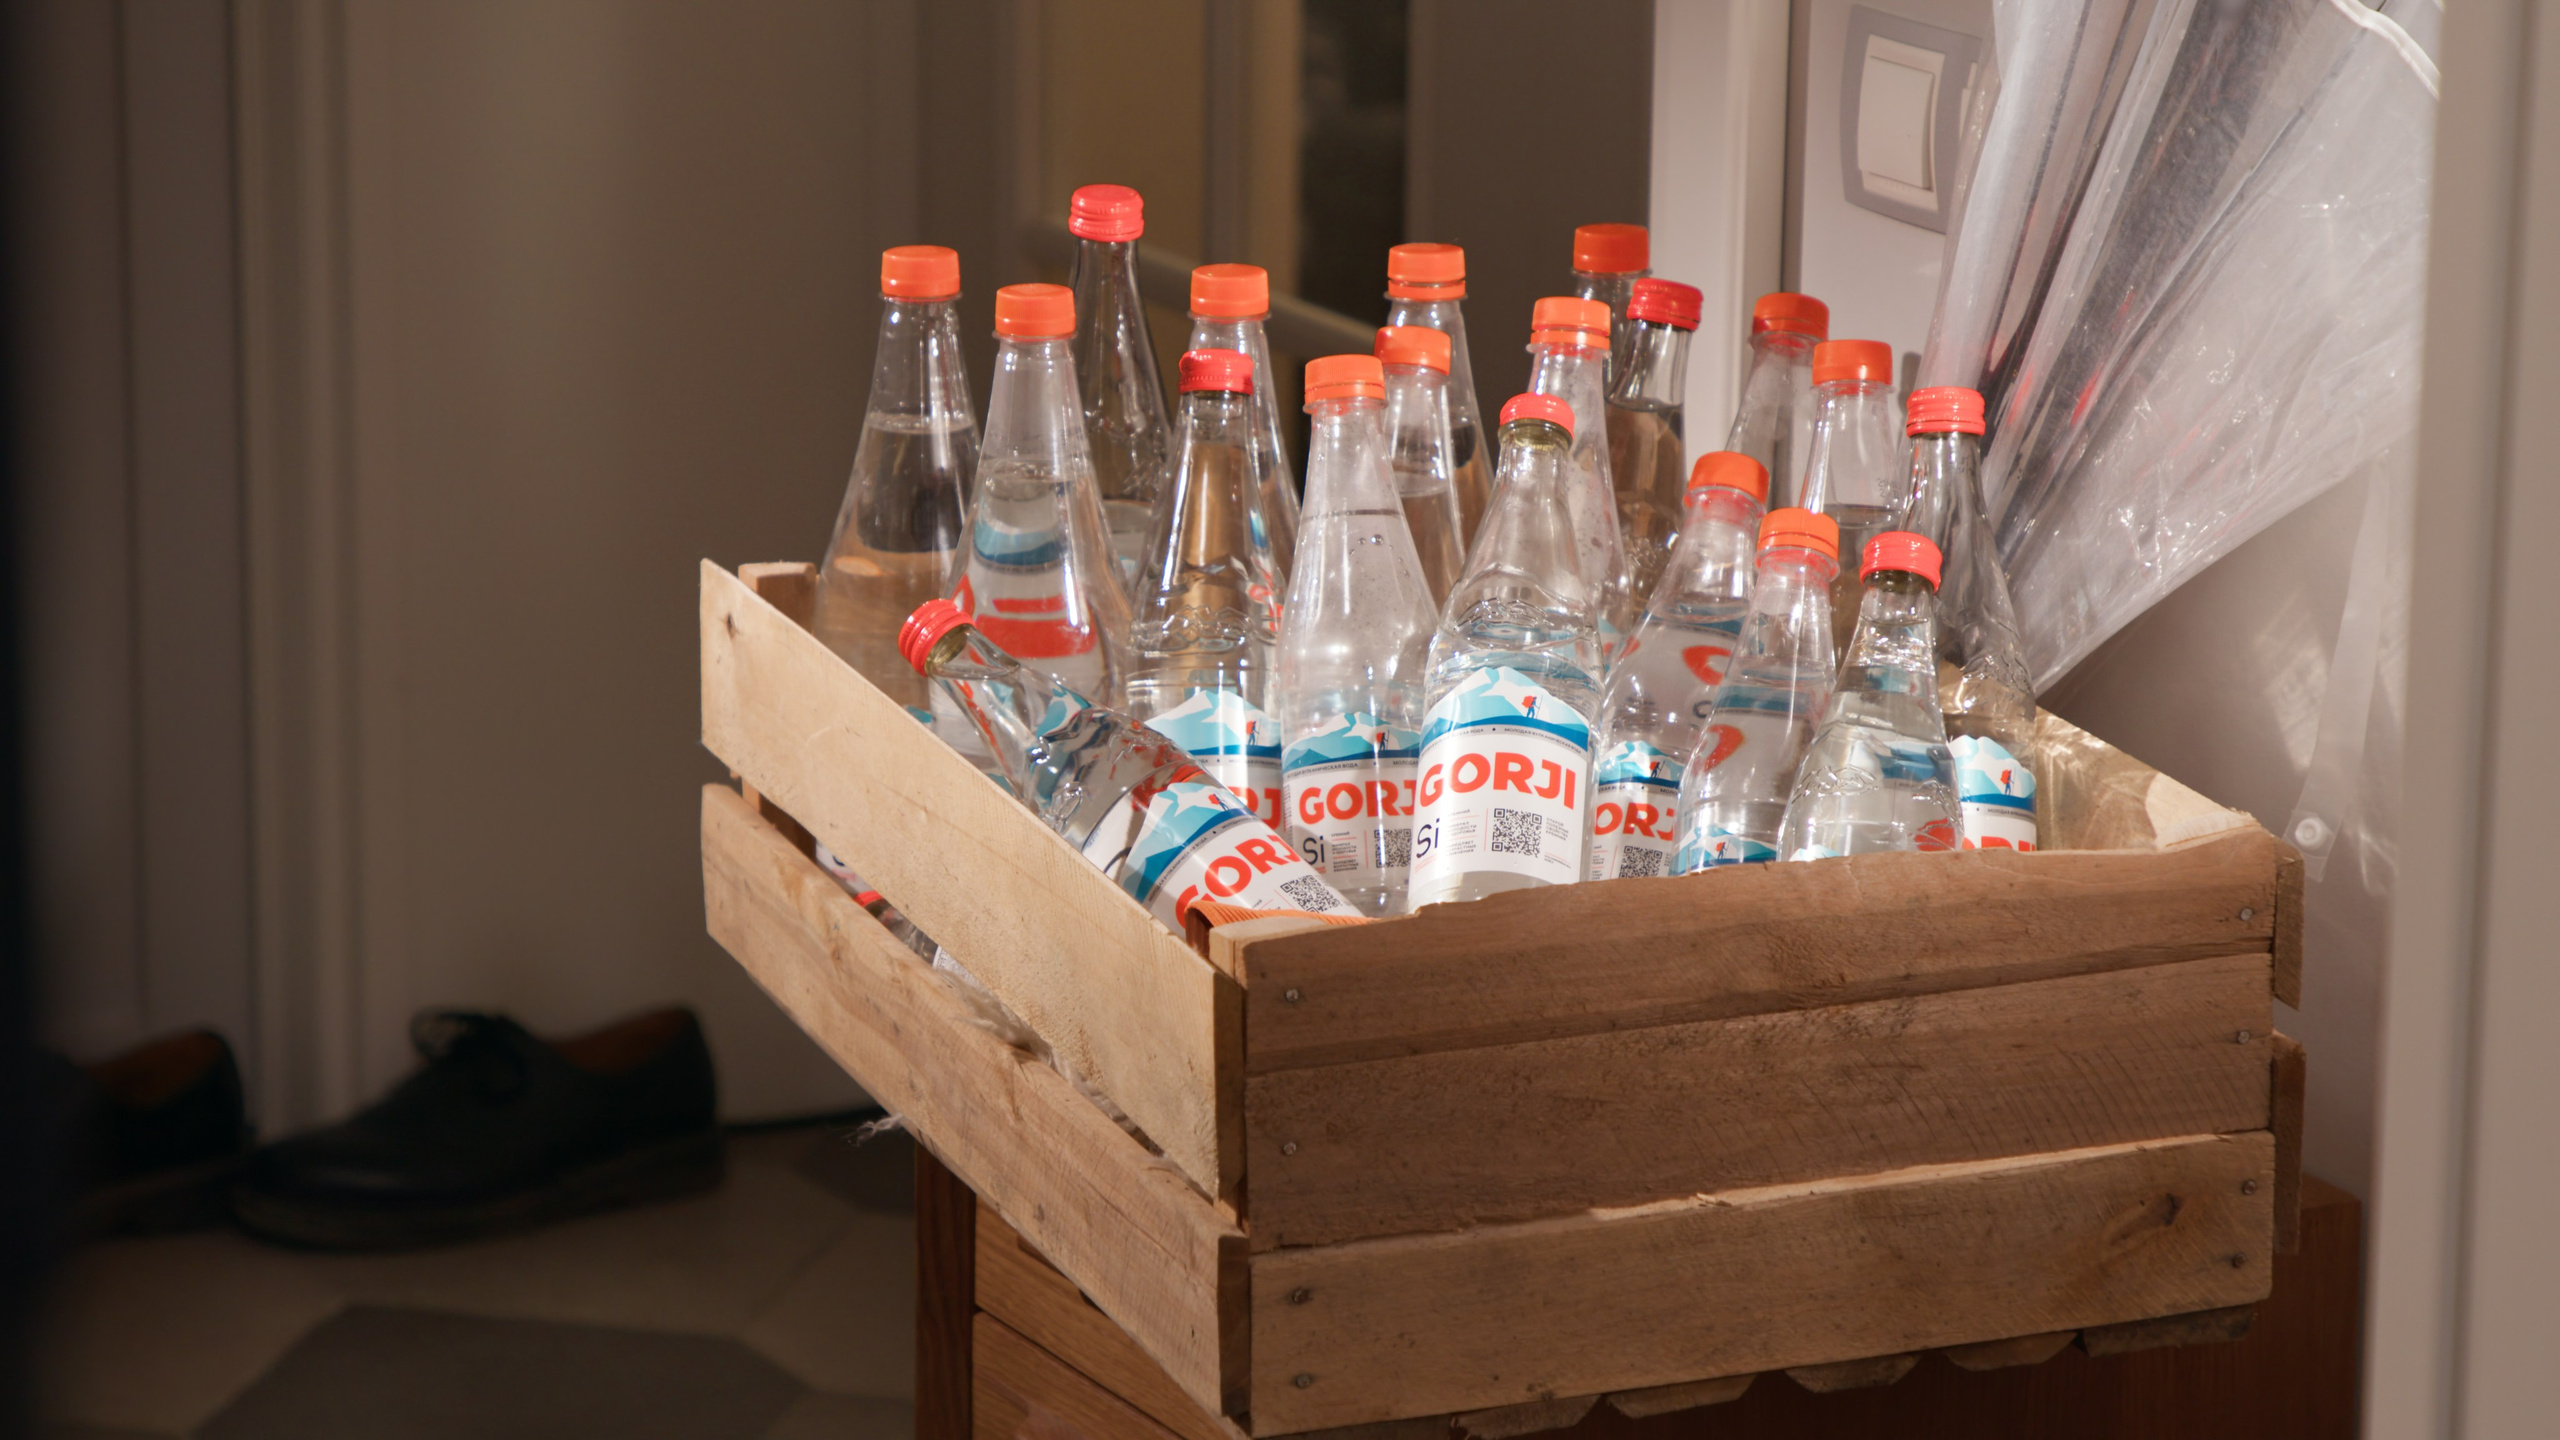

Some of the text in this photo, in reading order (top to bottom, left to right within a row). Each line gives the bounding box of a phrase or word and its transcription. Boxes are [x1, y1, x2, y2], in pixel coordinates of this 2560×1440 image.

[1420, 751, 1576, 810] GORJI
[1302, 835, 1326, 866] Si
[1416, 817, 1441, 859] Si
